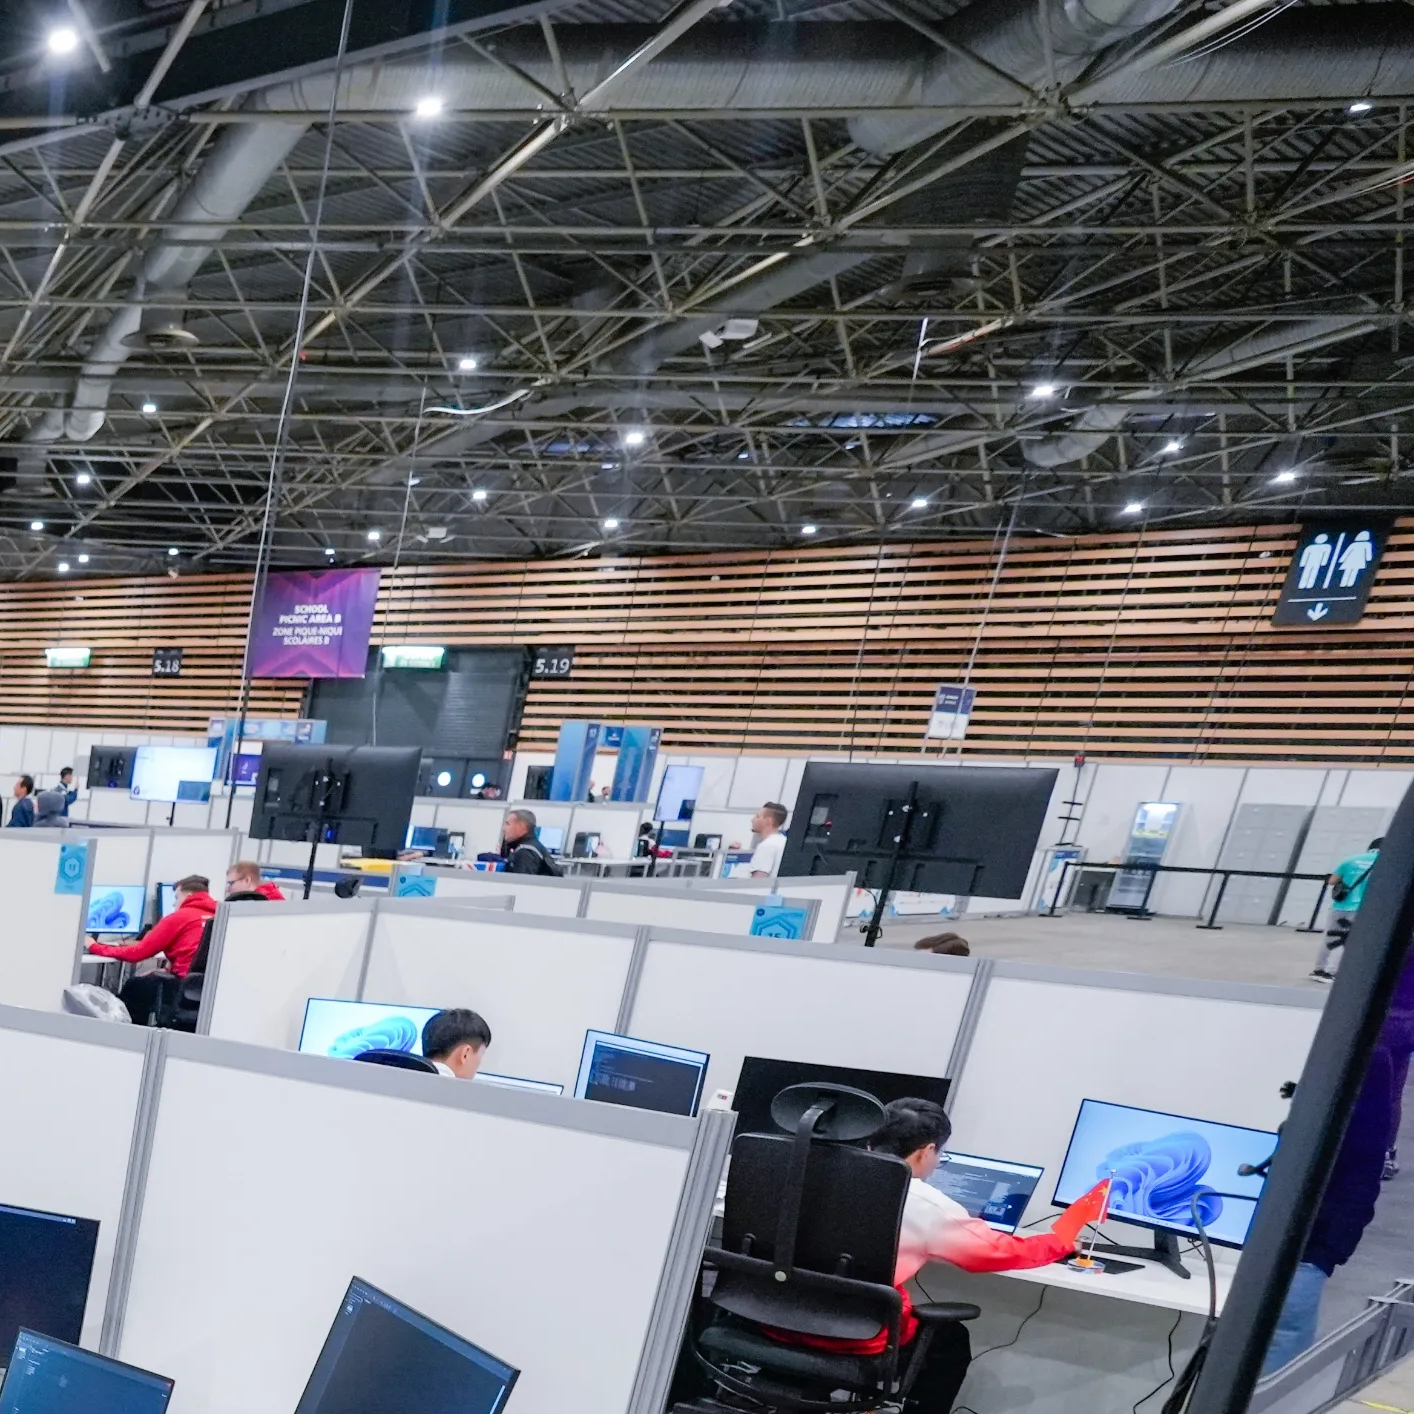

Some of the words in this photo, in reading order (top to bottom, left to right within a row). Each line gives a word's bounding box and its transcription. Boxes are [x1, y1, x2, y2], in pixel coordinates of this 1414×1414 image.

[294, 604, 328, 614] SCHOOL
[279, 614, 308, 624] PICNIC
[308, 614, 333, 624] AREA
[334, 614, 341, 623] B
[273, 627, 293, 636] ZONE
[283, 636, 323, 646] SCOLAIRES
[154, 659, 179, 673] 5.18
[535, 658, 570, 674] 5.19
